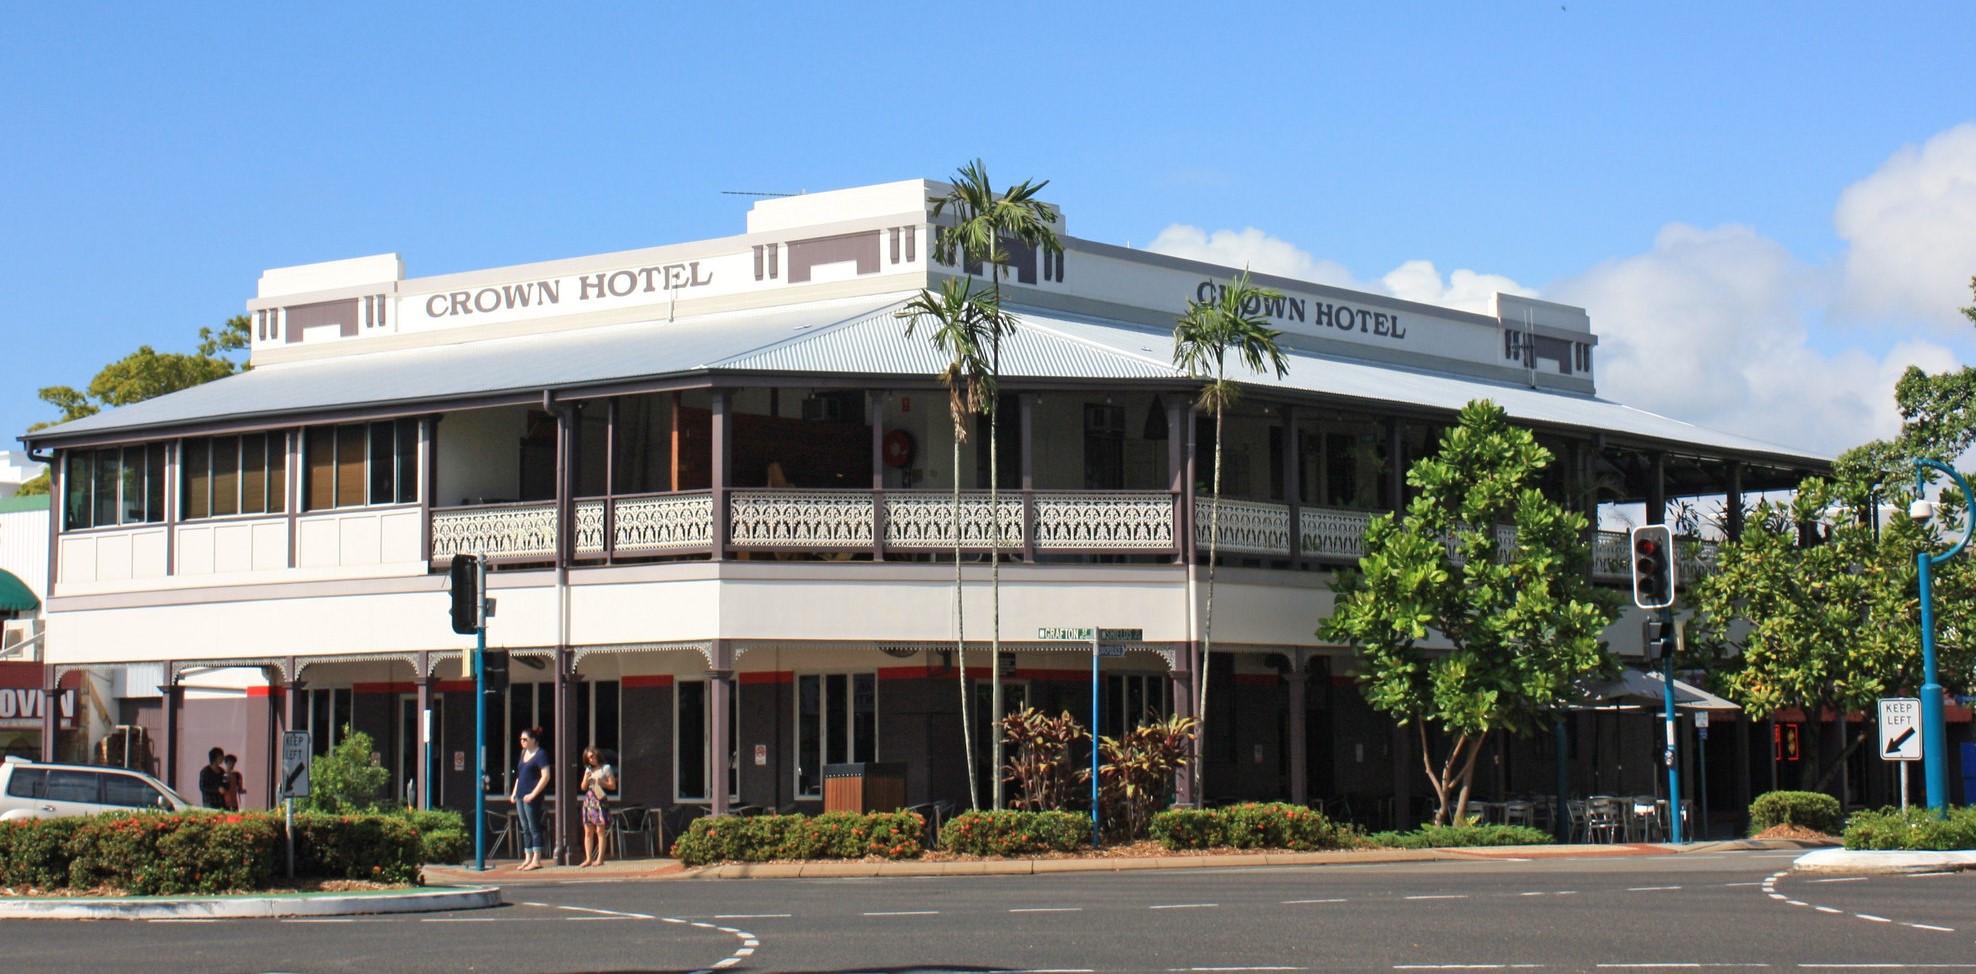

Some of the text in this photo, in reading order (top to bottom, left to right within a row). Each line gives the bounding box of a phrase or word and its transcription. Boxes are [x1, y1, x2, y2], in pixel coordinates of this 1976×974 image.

[426, 262, 713, 318] CROWN HOTEL
[1316, 301, 1406, 339] HOTEL
[1045, 628, 1079, 639] GRAFTON
[1886, 704, 1912, 713] KEEP
[1888, 716, 1911, 725] LEFT
[286, 736, 304, 747] KEEP
[286, 749, 302, 760] LEFT
